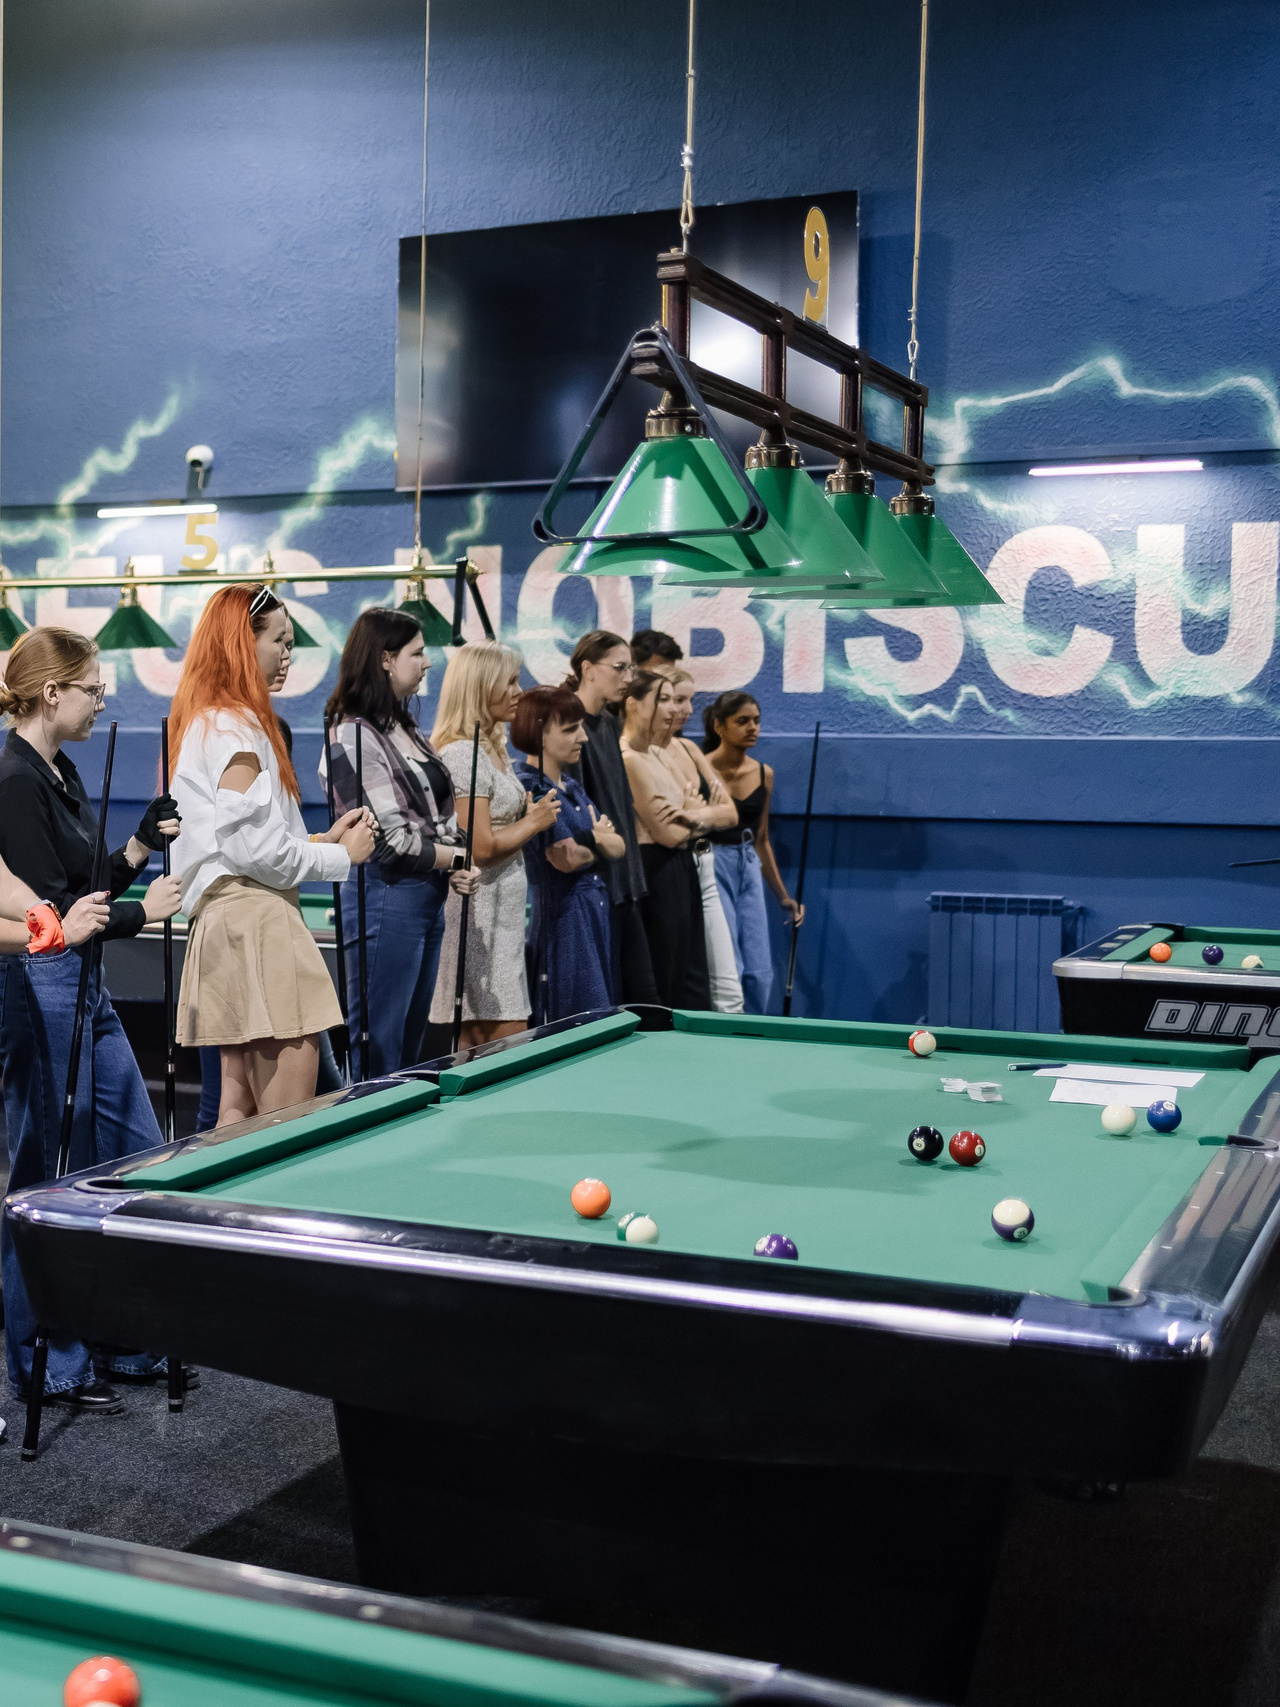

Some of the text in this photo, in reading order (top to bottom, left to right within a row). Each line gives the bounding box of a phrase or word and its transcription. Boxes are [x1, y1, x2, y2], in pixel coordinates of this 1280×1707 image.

[803, 206, 830, 323] 9
[180, 513, 219, 569] 5
[1144, 998, 1280, 1038] DIN
